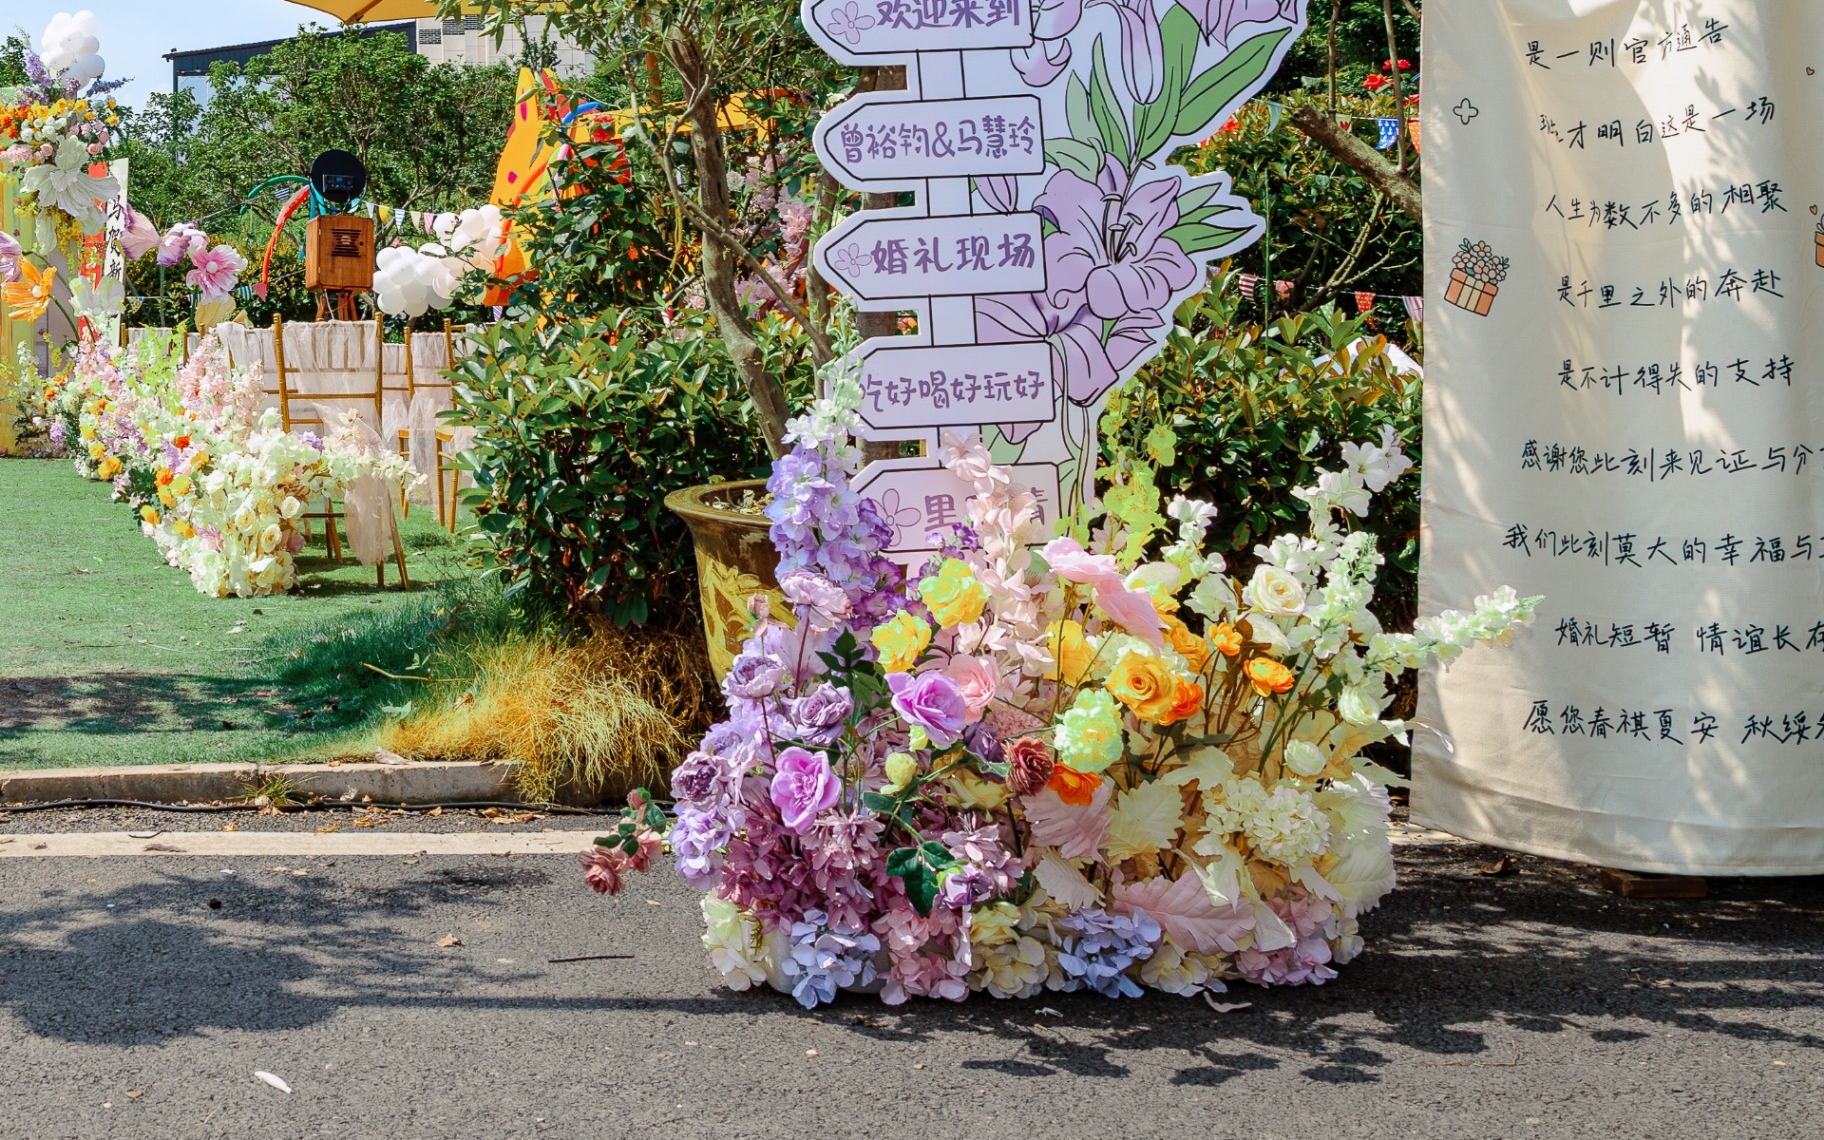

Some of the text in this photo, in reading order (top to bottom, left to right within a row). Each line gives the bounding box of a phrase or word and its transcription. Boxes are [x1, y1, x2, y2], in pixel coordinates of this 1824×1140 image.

[1525, 18, 1728, 70] 是一则官方通告
[1546, 180, 1788, 230] 人生为数不多的相聚
[870, 233, 1035, 275] 婚礼现场
[1557, 268, 1784, 308] 是千里之外的奔赴
[860, 370, 1045, 412] 吃好喝好玩好
[1558, 354, 1795, 395] 是不计得失的支持
[1521, 439, 1824, 482] 感谢您此刻来见证与分
[1502, 523, 1824, 568] 我们此刻莫大的幸福与
[1555, 616, 1675, 654] 婚礼短暂
[1523, 699, 1719, 745] 愿您春祺夏安
